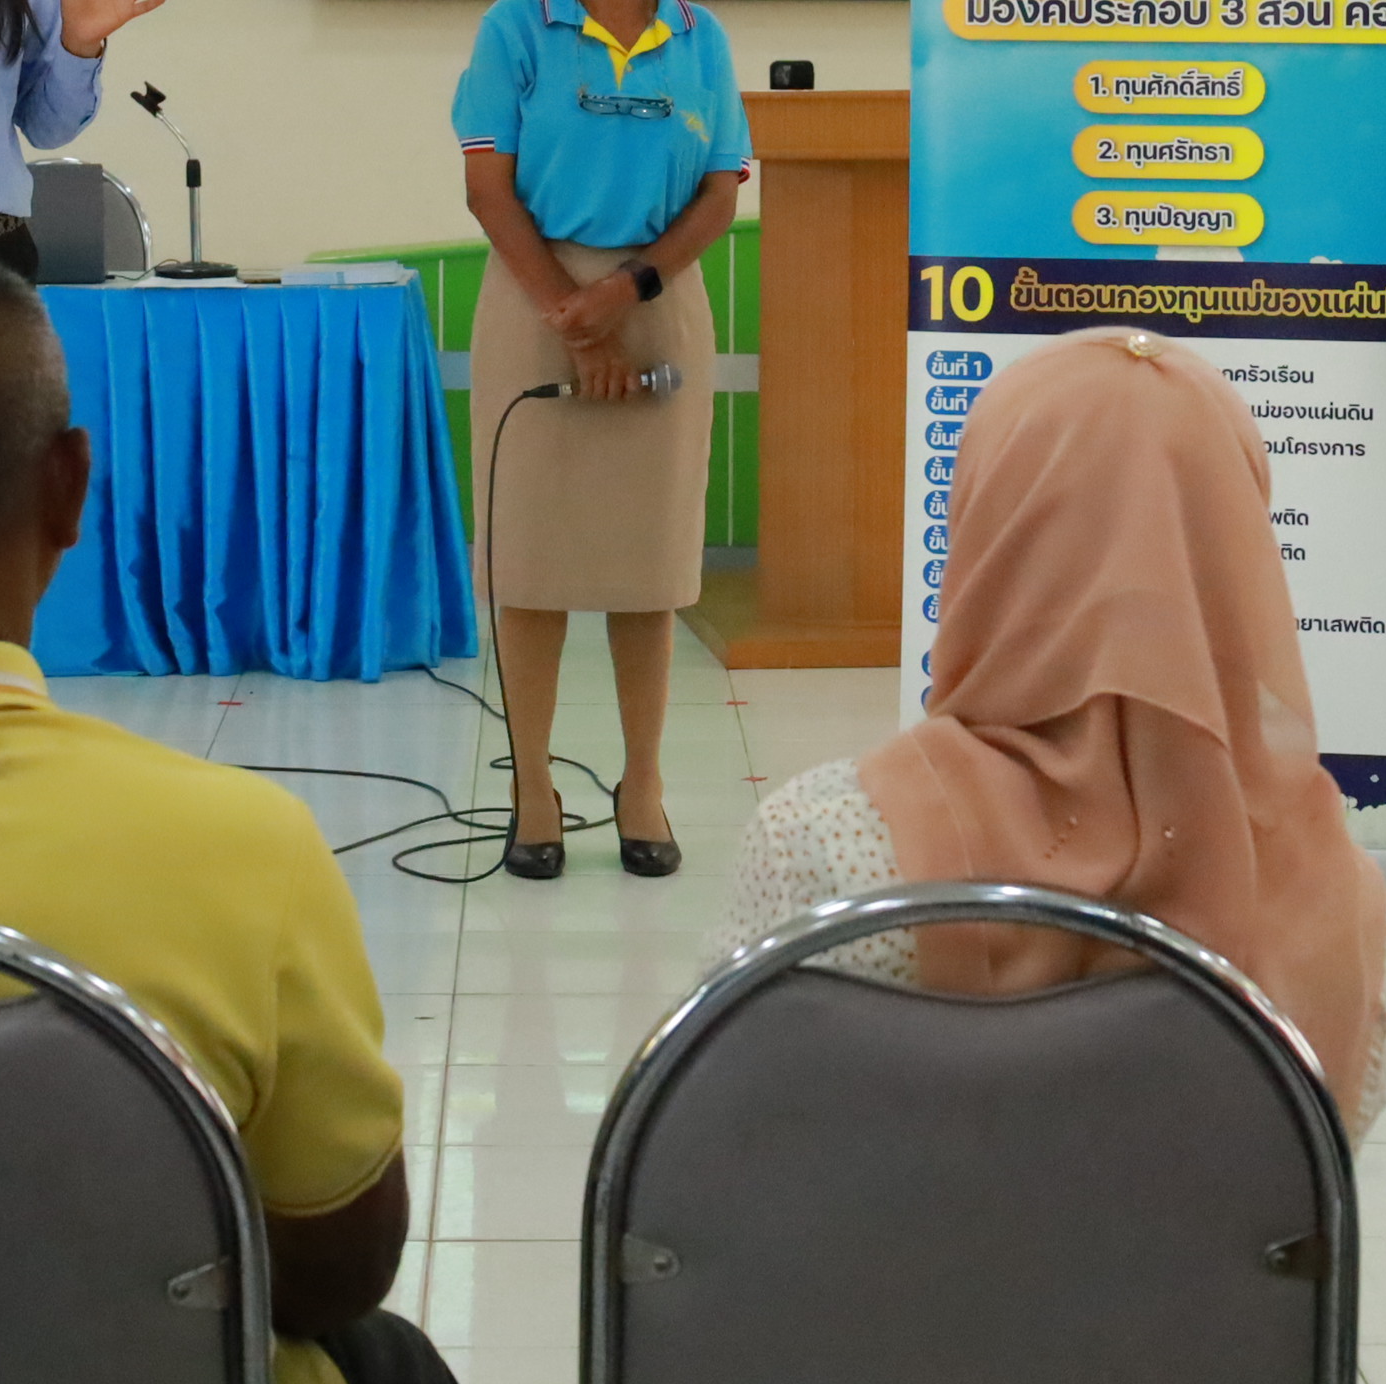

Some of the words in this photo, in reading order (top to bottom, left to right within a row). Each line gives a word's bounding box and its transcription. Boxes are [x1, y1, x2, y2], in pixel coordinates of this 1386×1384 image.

[1090, 75, 1107, 95] 1.
[1114, 70, 1242, 102] ทุนศักดิ์สิทธิ์
[1098, 141, 1119, 160] 2.
[1126, 139, 1230, 167] ทุนศรัทธา
[1096, 207, 1117, 226] 3.
[1125, 205, 1232, 232] ทุนปัญญา
[920, 265, 995, 322] 10
[931, 353, 968, 376] ขั้นที่
[973, 360, 983, 376] 1
[930, 386, 968, 412] ขั้นที่
[1250, 400, 1374, 421] แม่ของแผ่นดิน
